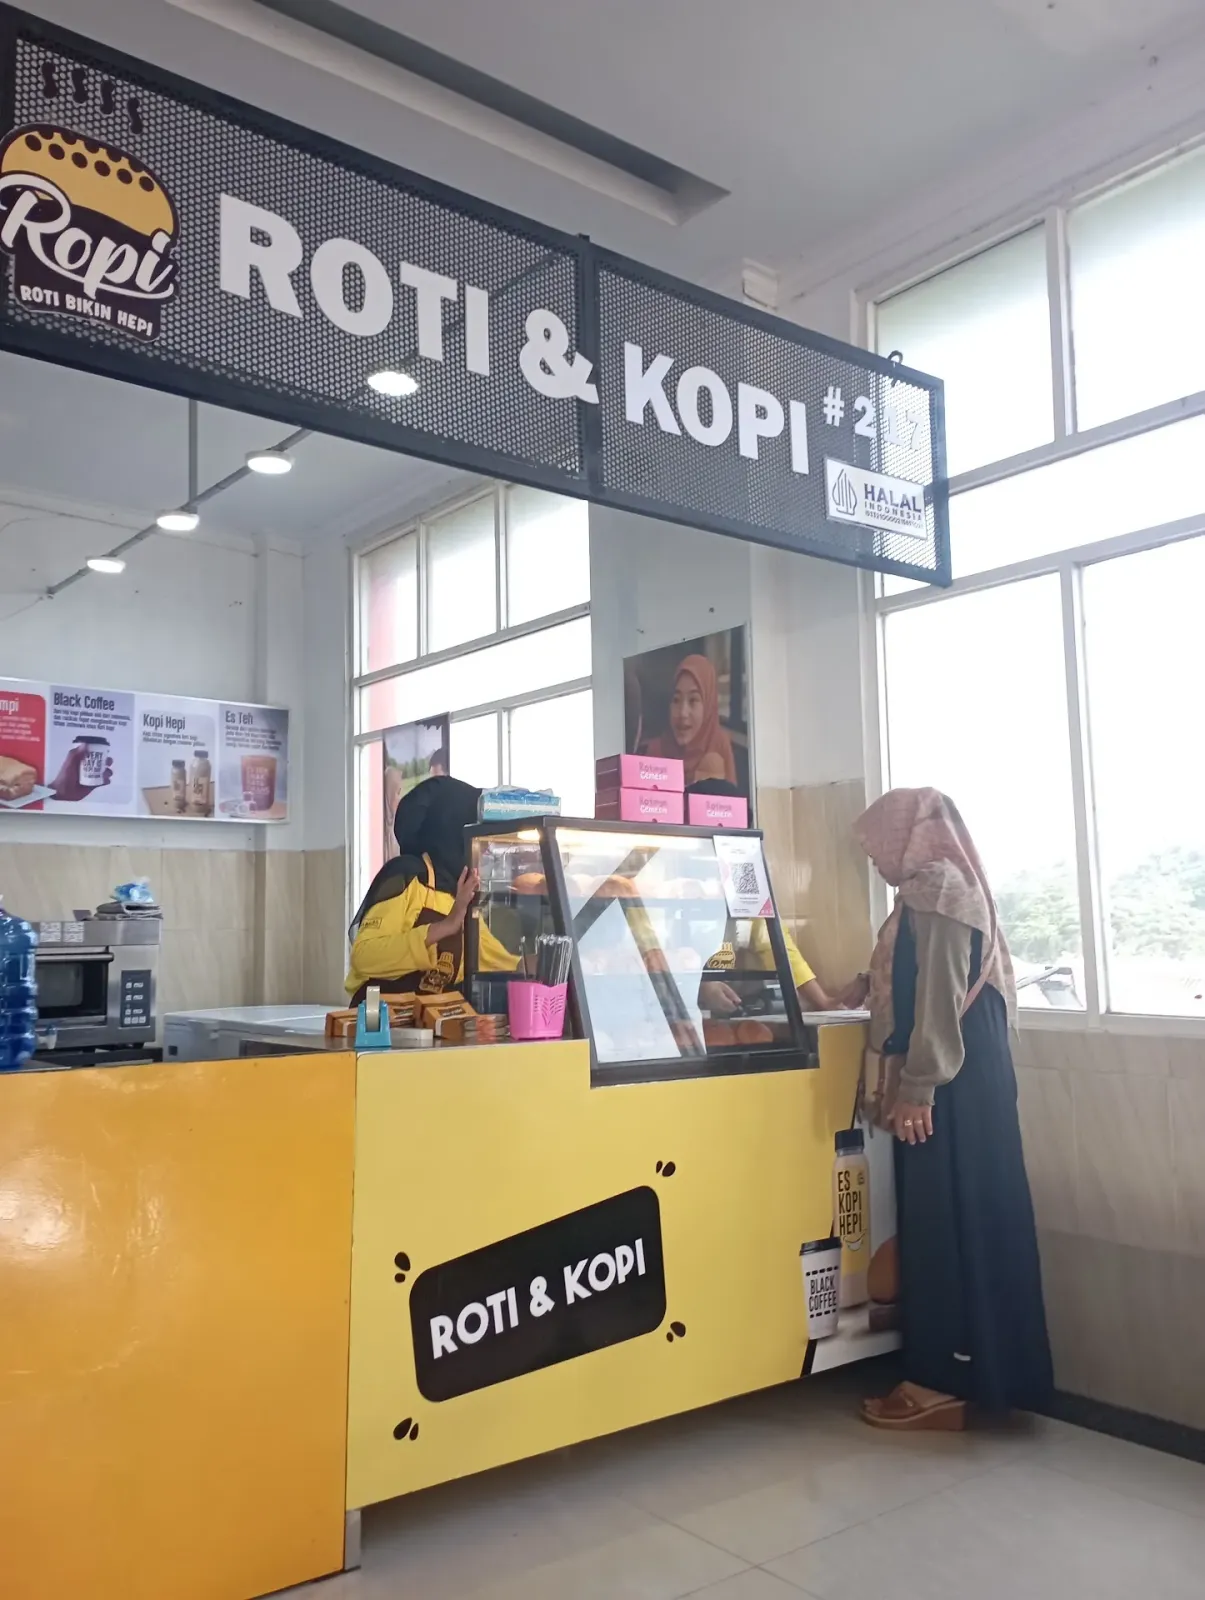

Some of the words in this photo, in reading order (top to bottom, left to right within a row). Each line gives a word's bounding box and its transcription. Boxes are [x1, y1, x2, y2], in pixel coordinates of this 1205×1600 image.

[0, 173, 174, 299] Ropi
[20, 285, 60, 306] ROTI
[66, 294, 111, 320] BIKIN
[117, 310, 153, 336] HEPI
[219, 193, 490, 377] ROTI
[519, 308, 599, 404] &
[624, 341, 809, 475] KOPI
[864, 483, 922, 513] HALAL
[864, 501, 922, 521] INDONESIA
[54, 692, 81, 707] Black
[84, 695, 115, 711] Coffee
[143, 714, 163, 731] Kopi
[165, 716, 186, 733] Hepi
[225, 710, 236, 724] Es
[238, 711, 253, 725] Teh
[837, 1170, 850, 1193] ES
[838, 1190, 862, 1213] KOPI
[839, 1212, 862, 1236] HEPI
[810, 1275, 835, 1295] BLACK
[429, 1286, 519, 1360] ROTI
[529, 1275, 555, 1317] &
[563, 1237, 646, 1305] KOPI
[808, 1291, 837, 1312] COFFEE
